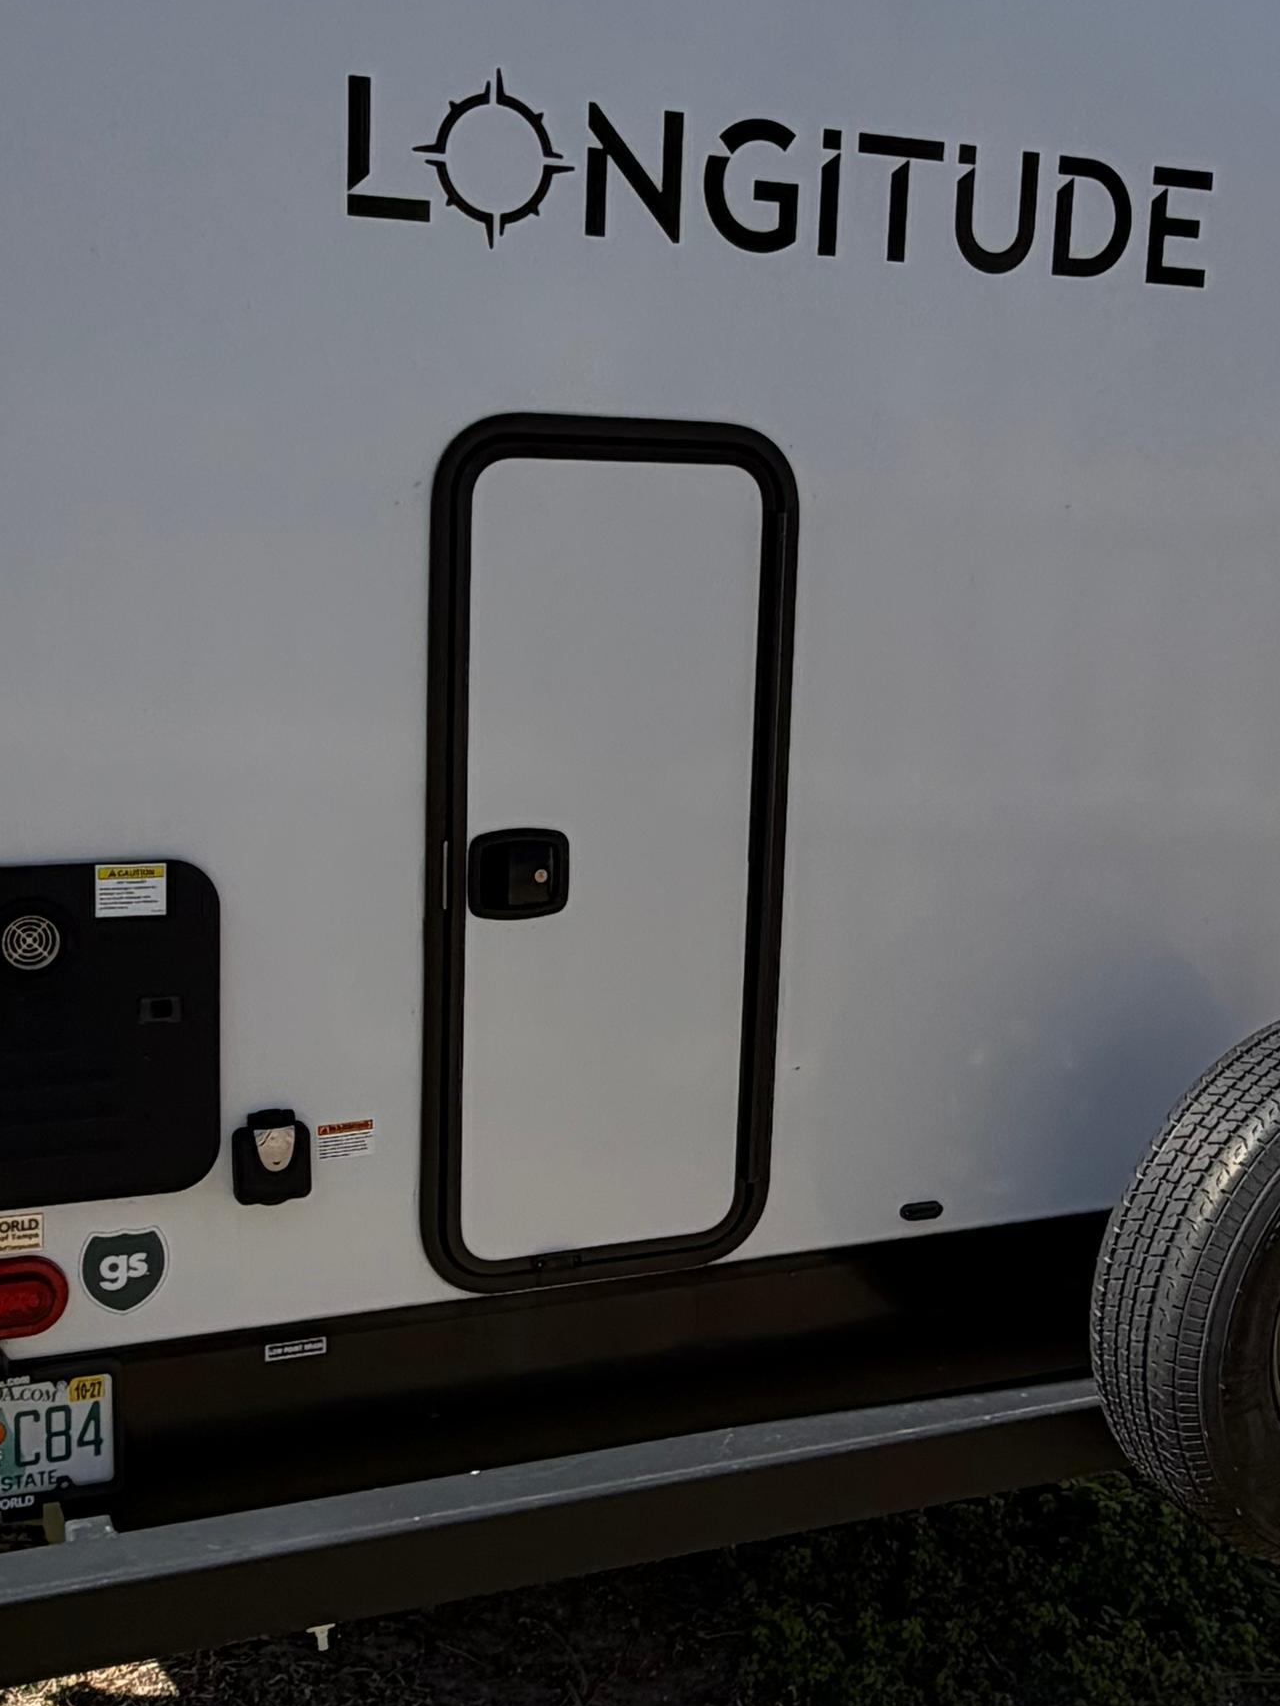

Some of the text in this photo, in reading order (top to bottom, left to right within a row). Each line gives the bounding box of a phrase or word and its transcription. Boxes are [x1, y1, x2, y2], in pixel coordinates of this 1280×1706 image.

[347, 67, 1214, 289] LONGITUDE
[117, 868, 155, 877] CAUTION
[0, 1232, 39, 1242] of Tampa
[99, 1252, 148, 1291] gs
[74, 1380, 102, 1401] 10-27
[14, 1400, 105, 1468] C84
[0, 1468, 58, 1492] STATE
